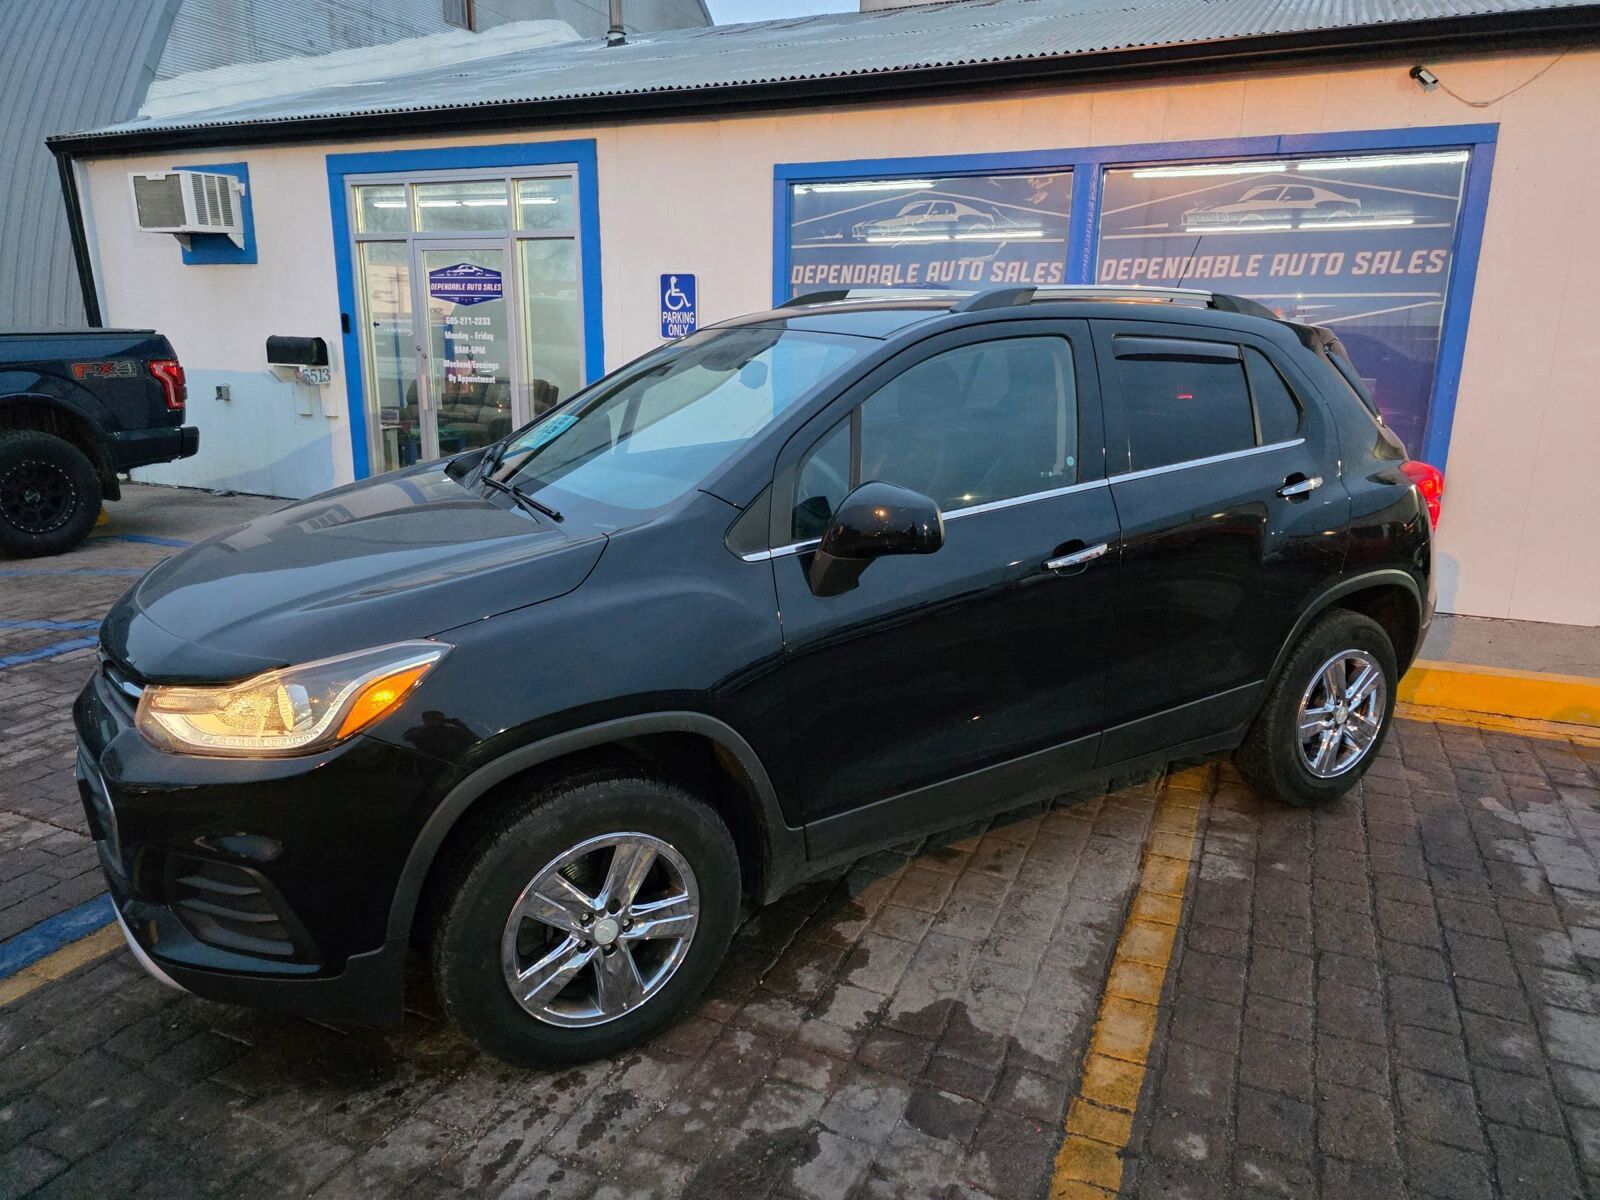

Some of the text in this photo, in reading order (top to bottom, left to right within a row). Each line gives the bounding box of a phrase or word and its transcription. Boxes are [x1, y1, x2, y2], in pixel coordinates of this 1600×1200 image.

[1100, 249, 1447, 282] DEPENDABLE AUTO SALES
[791, 260, 1064, 285] DEPENDABLE AUTO SALES
[483, 283, 501, 291] SALES
[662, 311, 695, 324] PARKING
[445, 331, 468, 341] Monday
[474, 331, 494, 342] Friday
[668, 324, 689, 336] ONLY
[71, 360, 137, 379] FX4
[302, 368, 331, 385] 5513
[448, 374, 496, 384] By Appointment
